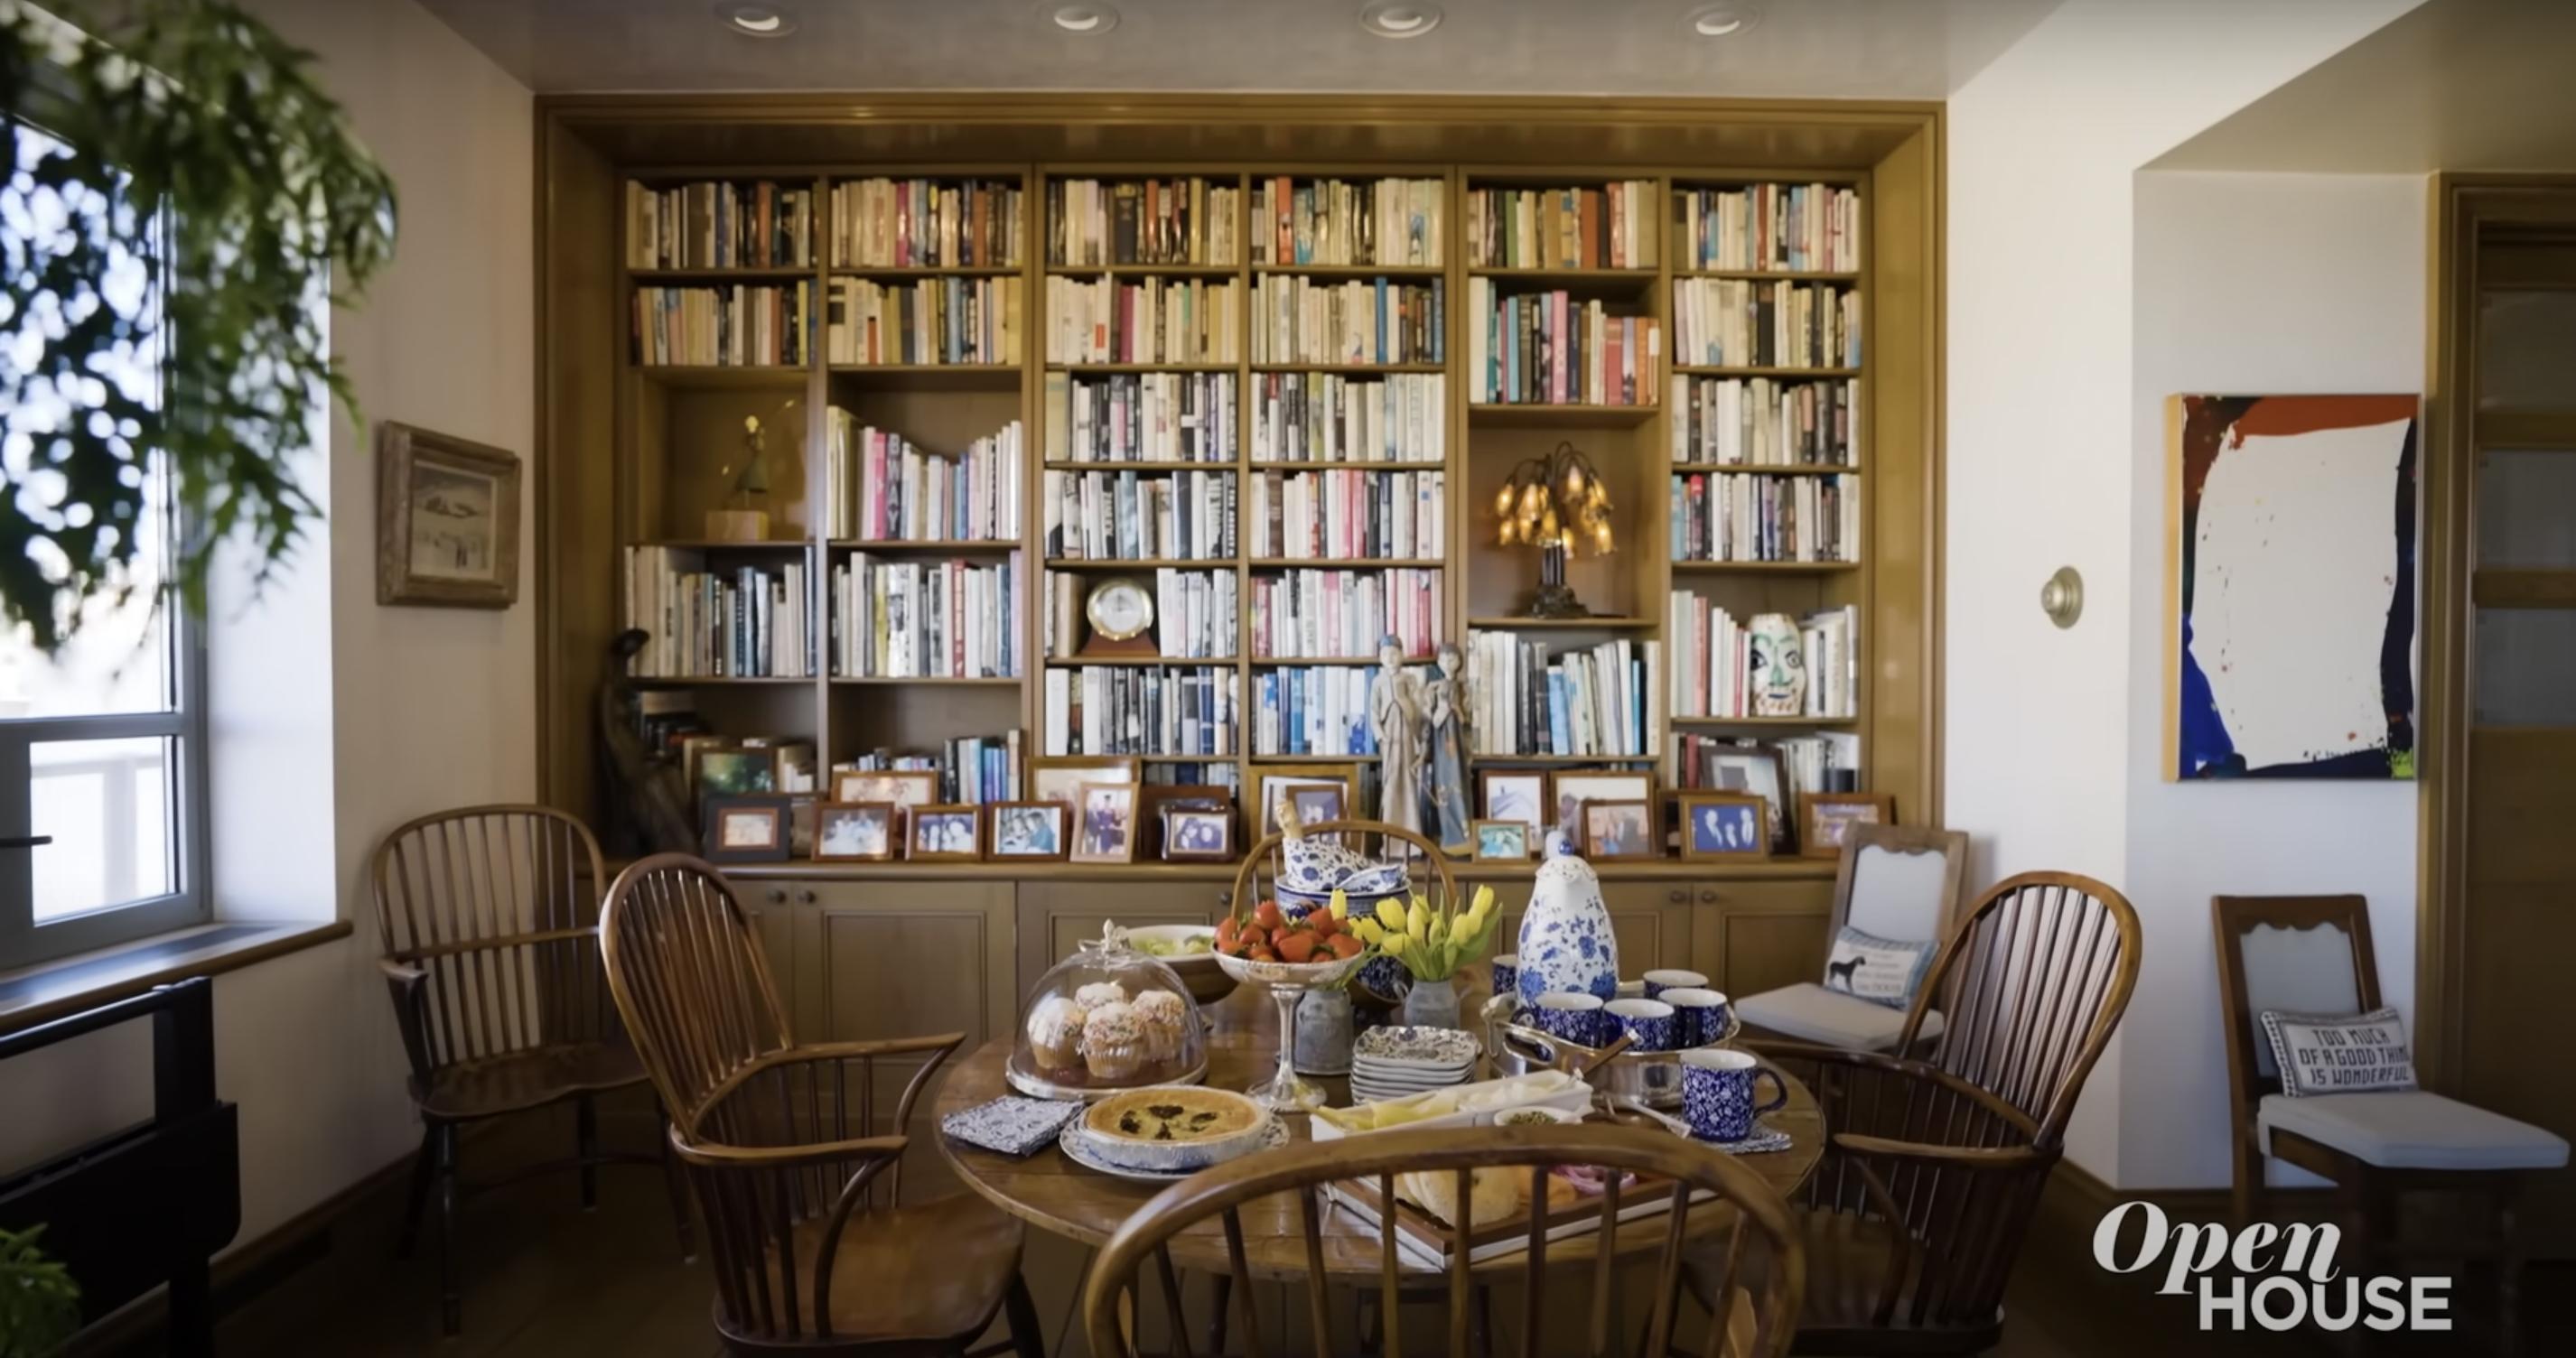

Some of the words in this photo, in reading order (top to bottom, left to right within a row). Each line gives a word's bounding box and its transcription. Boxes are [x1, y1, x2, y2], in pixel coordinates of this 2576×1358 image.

[2311, 1029, 2347, 1046] TOO
[2347, 1028, 2391, 1046] MUCH
[2299, 1048, 2318, 1065] OF
[2322, 1048, 2334, 1065] A
[2335, 1047, 2376, 1066] GOOD
[2310, 1068, 2327, 1085] IS
[2332, 1065, 2409, 1085] WONDERFUL
